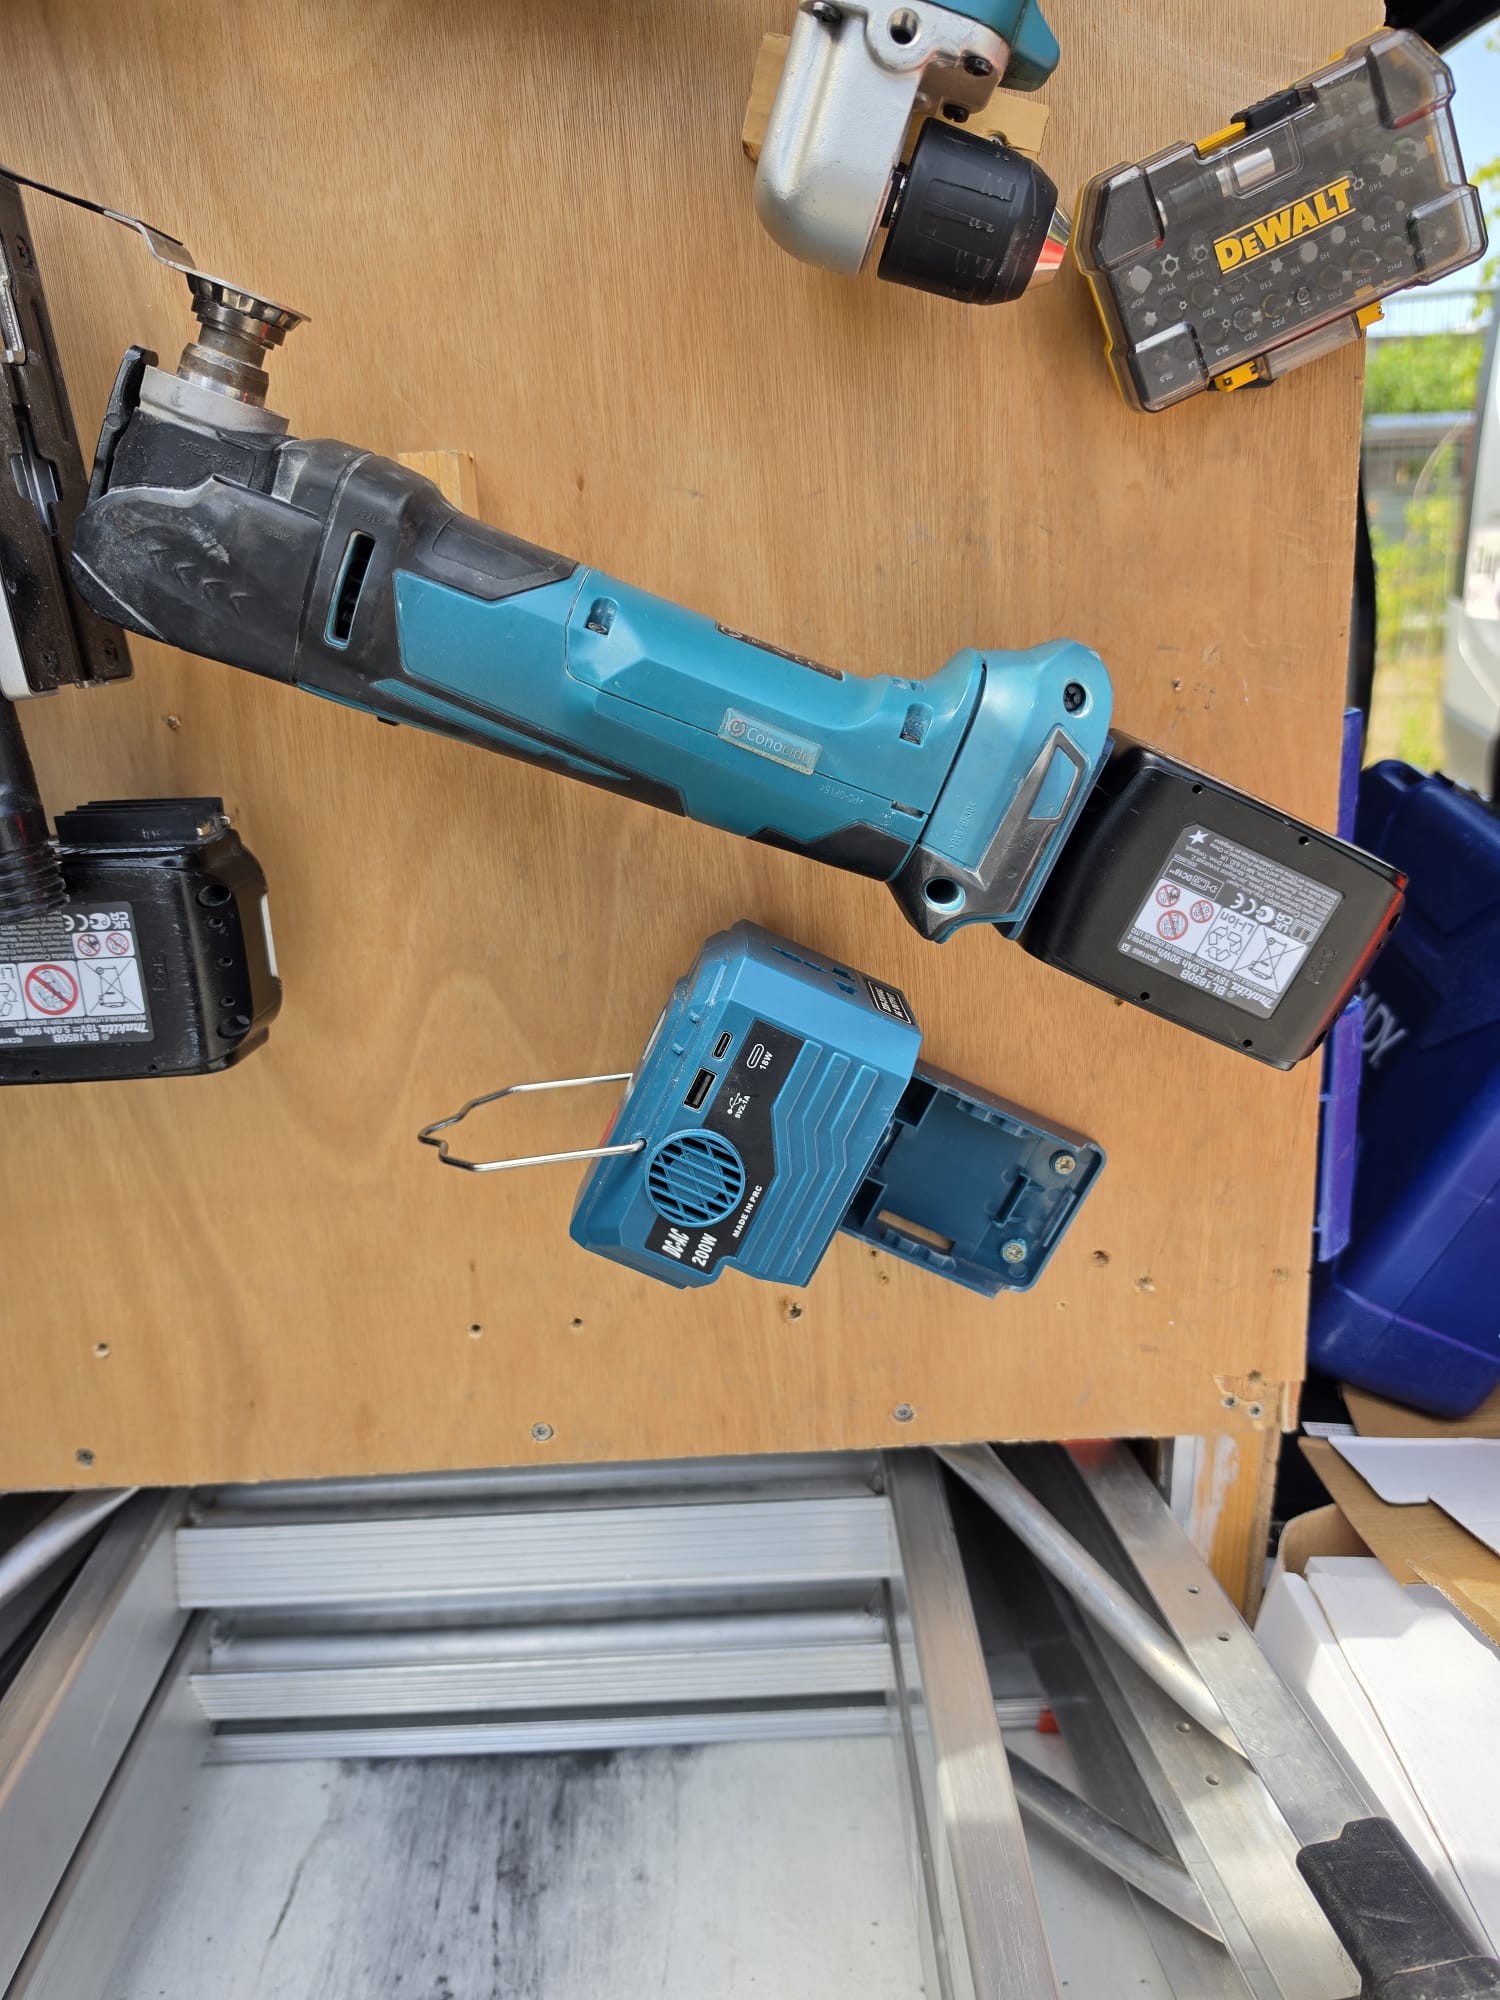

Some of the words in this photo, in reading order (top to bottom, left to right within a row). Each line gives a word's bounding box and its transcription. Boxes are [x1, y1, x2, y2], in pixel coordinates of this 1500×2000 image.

[1218, 910, 1254, 936] Li-ion
[1155, 947, 1181, 965] 90Wh
[1180, 967, 1225, 995] BL1850B
[14, 1027, 41, 1036] 90Wh
[52, 1032, 99, 1042] BL1850B
[759, 1052, 774, 1070] 18W
[748, 1183, 763, 1204] PRC
[743, 1201, 754, 1214] IN
[730, 1211, 749, 1238] MADE
[662, 1227, 690, 1259] DC-AC
[692, 1232, 718, 1267] 200W
